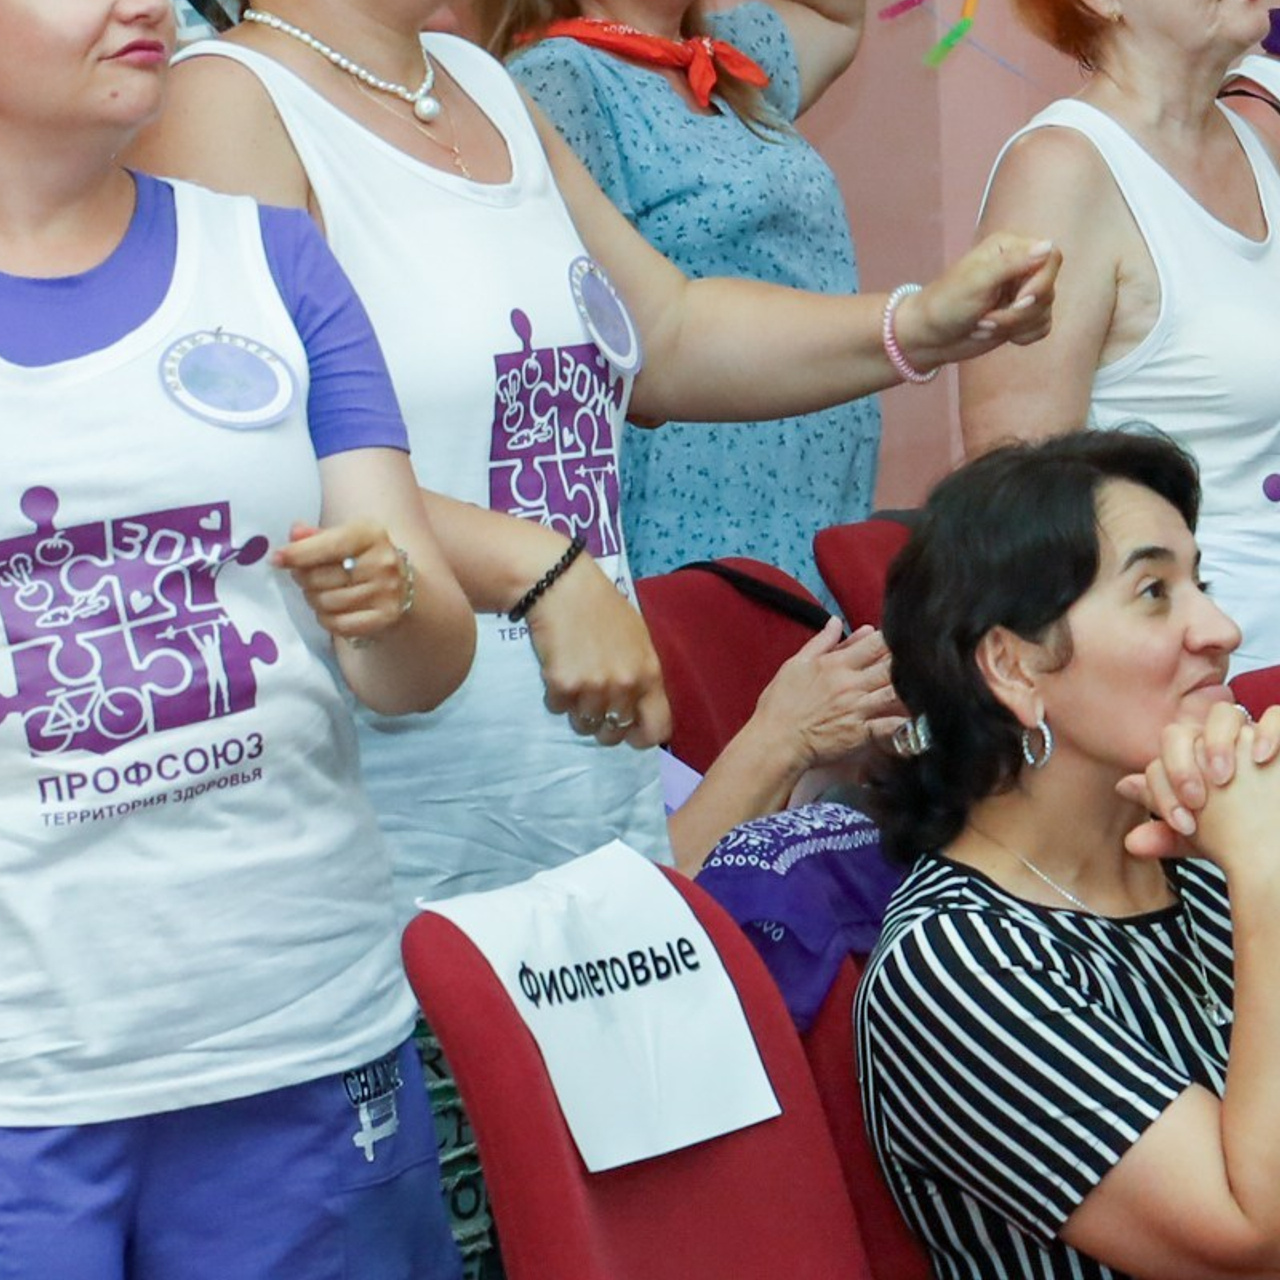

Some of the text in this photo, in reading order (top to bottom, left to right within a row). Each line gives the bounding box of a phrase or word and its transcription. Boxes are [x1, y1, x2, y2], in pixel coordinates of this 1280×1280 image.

[559, 350, 615, 424] ЗОЖ
[38, 732, 264, 804] ПРОФСОЮЗ
[41, 767, 263, 828] ТЕРРИТОРИЯ ЗДОРОВЬЯ
[518, 936, 701, 1009] Фиолетовые
